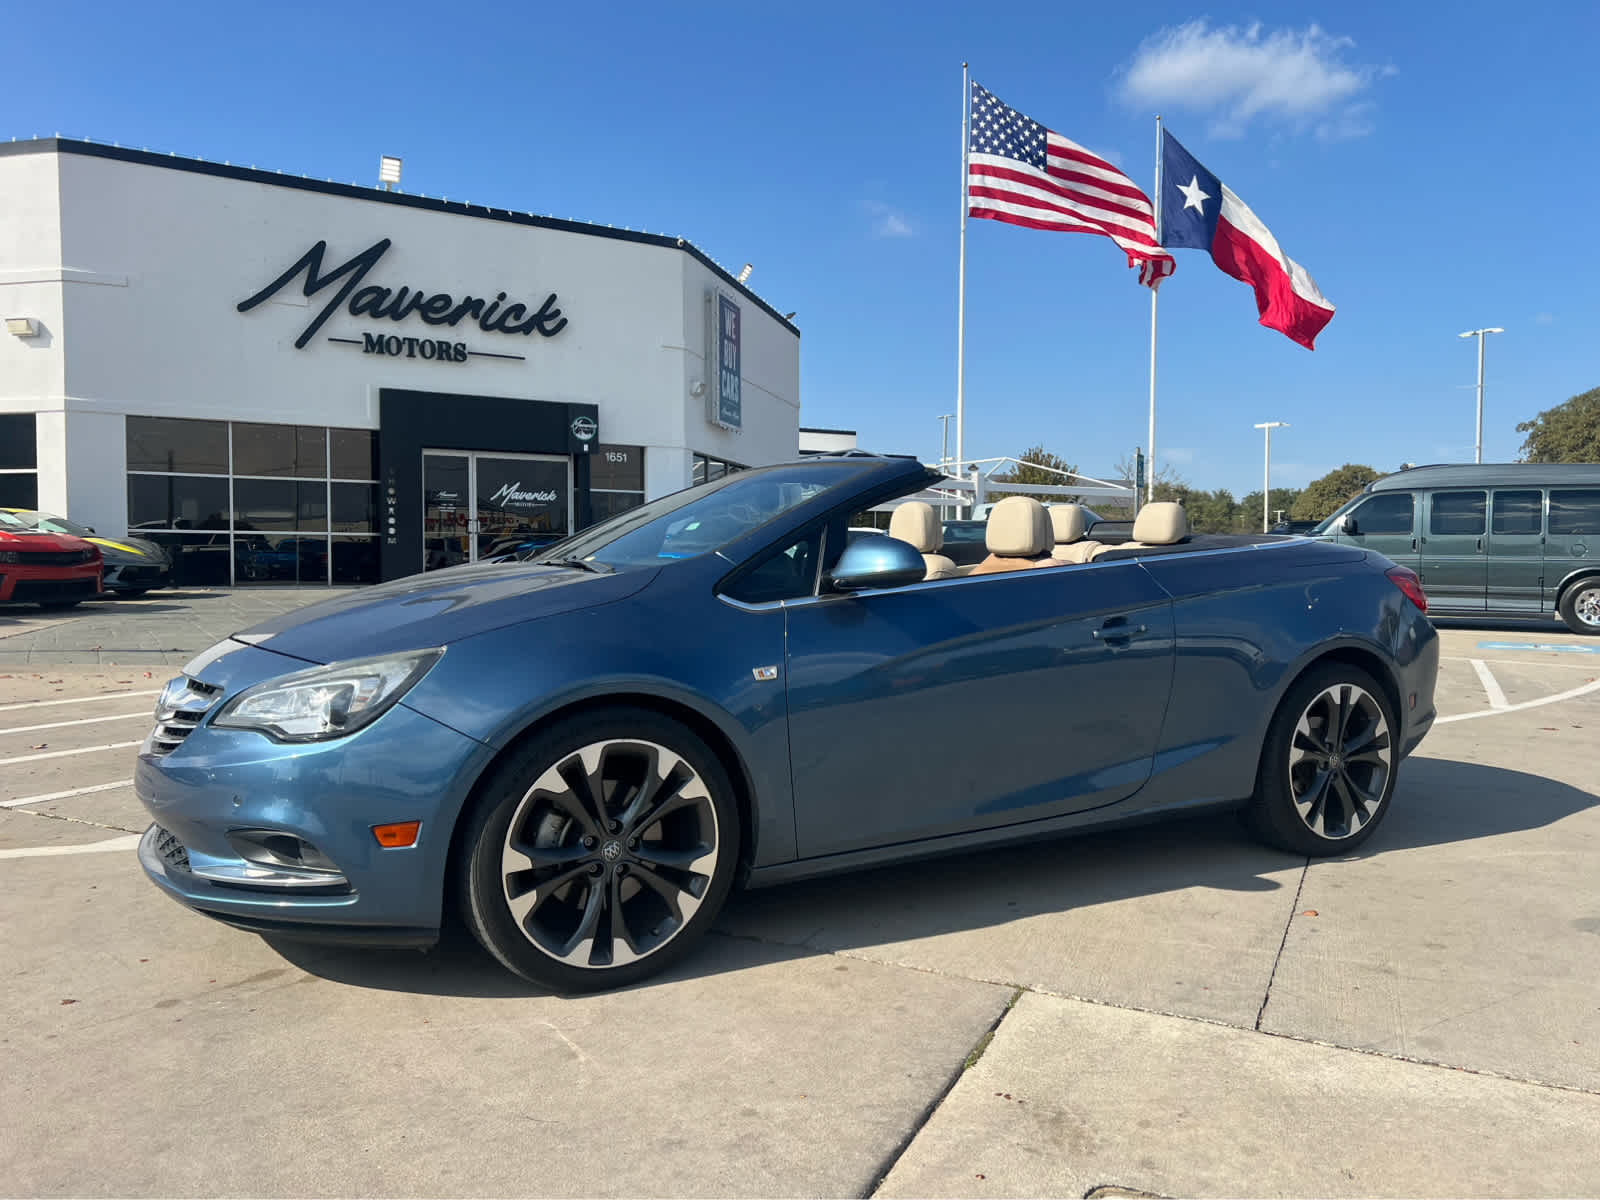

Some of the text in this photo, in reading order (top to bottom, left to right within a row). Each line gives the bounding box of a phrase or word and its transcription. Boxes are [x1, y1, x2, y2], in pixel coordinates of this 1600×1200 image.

[237, 238, 569, 350] Maverick
[362, 332, 468, 363] MOTORS
[722, 369, 739, 403] CARS
[605, 451, 628, 464] 1651
[386, 467, 397, 545] HOWROOM
[490, 481, 558, 508] Maverick
